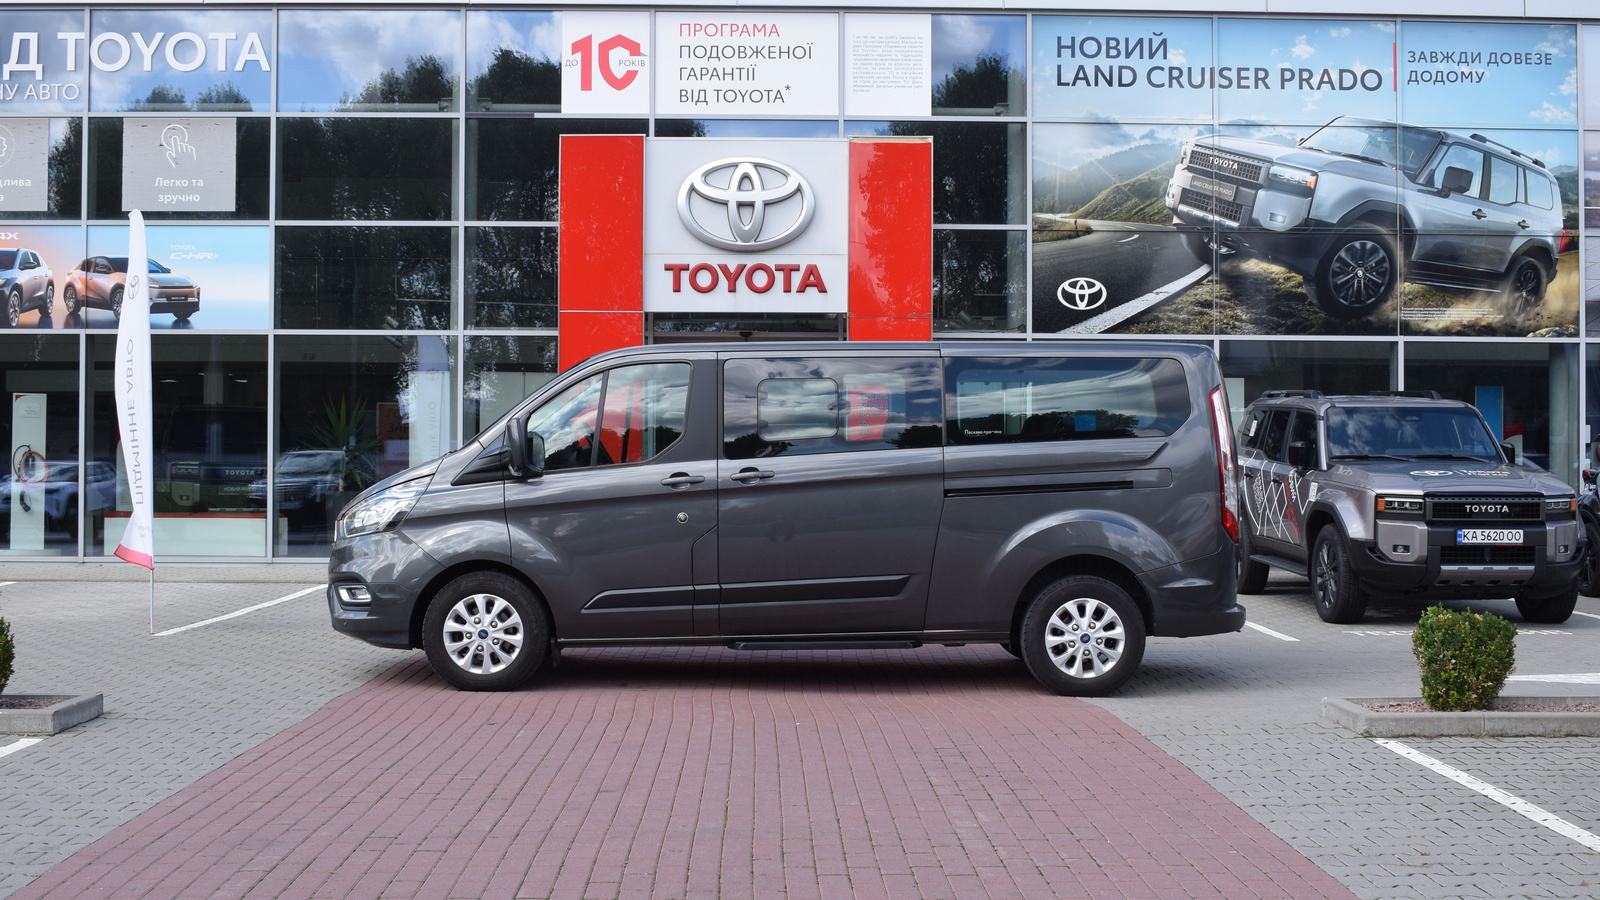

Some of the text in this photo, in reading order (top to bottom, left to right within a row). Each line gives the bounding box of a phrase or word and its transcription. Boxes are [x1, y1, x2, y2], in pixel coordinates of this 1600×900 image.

[678, 23, 781, 38] ПРОГРАМА
[678, 42, 814, 62] ПОДОВЖЕНОЇ
[1055, 31, 1169, 60] НОВИЙ
[2, 31, 271, 81] Д TOYOTA
[565, 59, 579, 69] ДО
[618, 59, 646, 68] РОКІВ
[1406, 50, 1553, 68] ЗАВЖДИ ДОВЕЗЕ
[678, 64, 757, 82] ГАРАНТІЇ
[1055, 64, 1383, 92] LAND CRUISER PRADO
[1406, 69, 1485, 86] ДОДОМУ
[24, 83, 80, 101] АВТО
[678, 89, 709, 105] ВІД
[1209, 156, 1238, 170] TOYOTA
[154, 177, 204, 188] Легко та
[157, 192, 201, 204] зручно
[663, 262, 828, 294] TOYOTA
[1465, 504, 1510, 513] TOYOTA
[1463, 530, 1478, 542] KA
[1480, 530, 1505, 542] 5620
